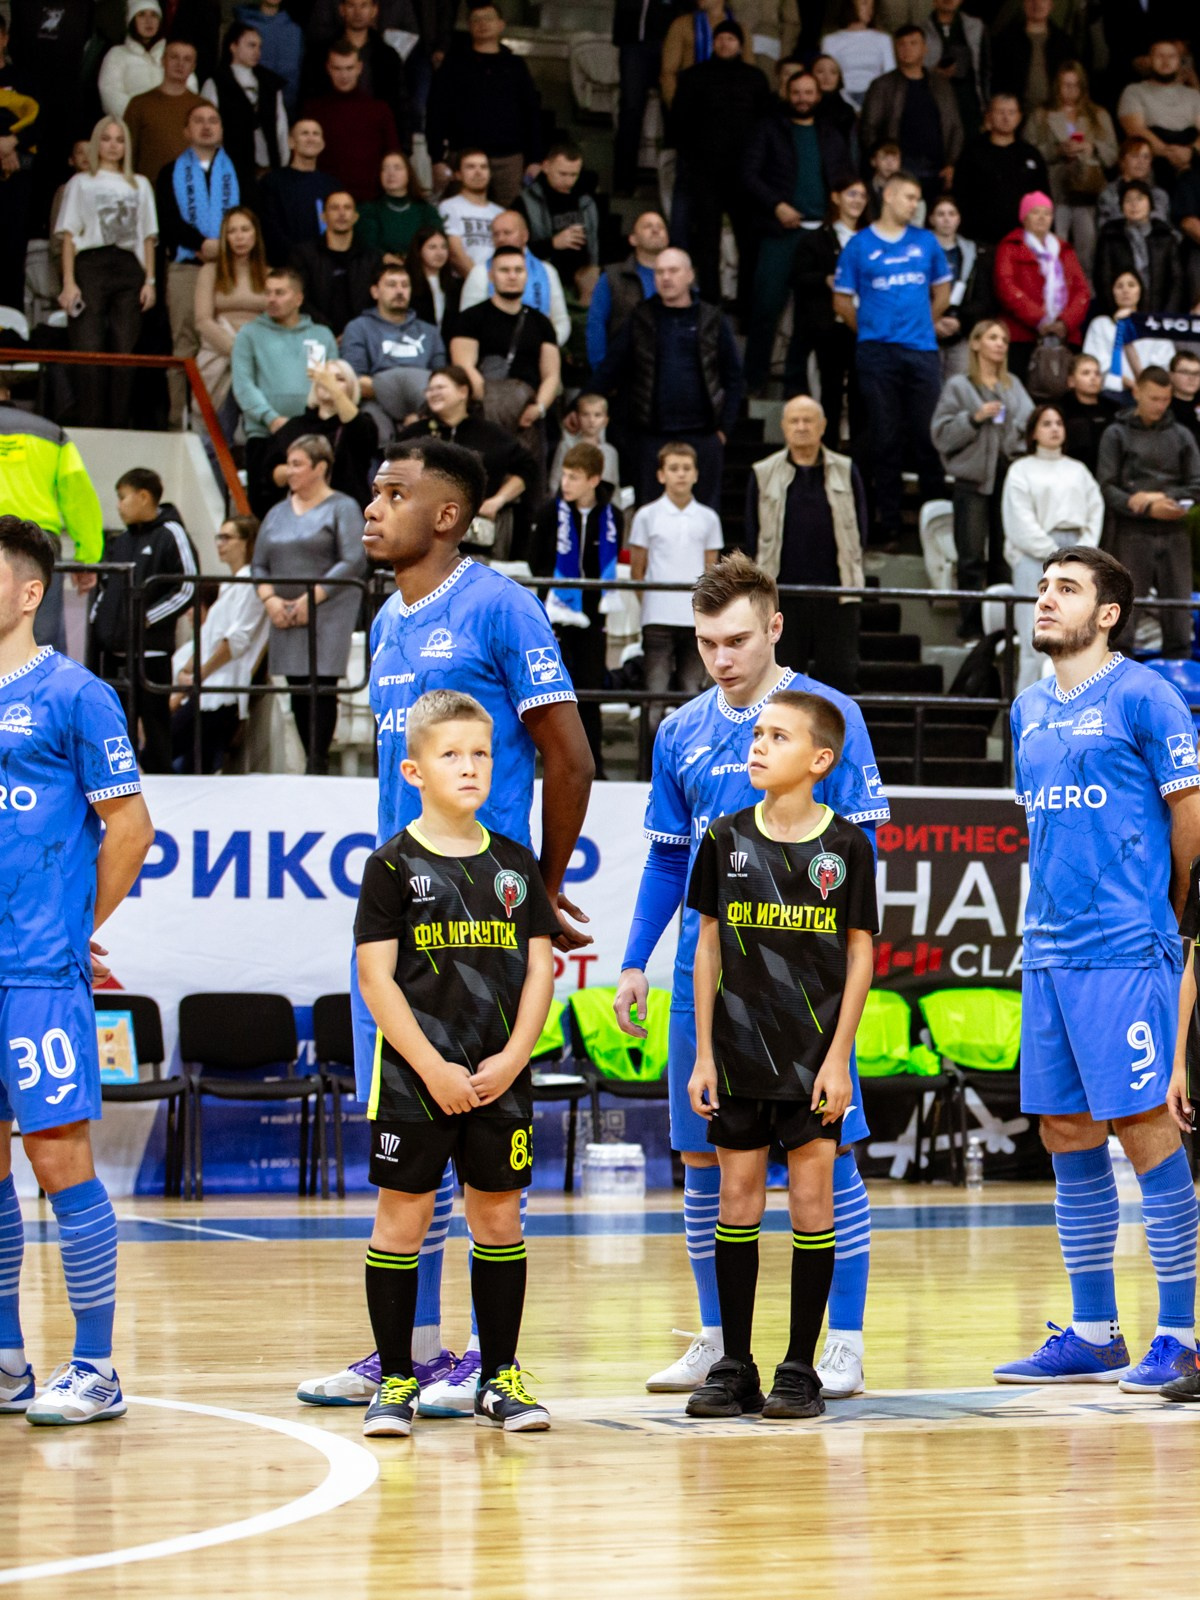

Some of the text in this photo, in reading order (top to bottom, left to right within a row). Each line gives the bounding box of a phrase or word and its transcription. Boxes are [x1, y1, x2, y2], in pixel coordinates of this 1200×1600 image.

[420, 650, 453, 659] ИРАЭРО
[378, 673, 416, 687] БЕТСИТИ
[1072, 729, 1103, 737] ИРАЭРО
[711, 762, 750, 776] БЕТСИ
[727, 901, 837, 930] ФК ИРКУТСК
[414, 921, 518, 947] ФК ИРКУТСК
[9, 1028, 76, 1090] 30
[1126, 1021, 1156, 1072] 9
[510, 1125, 533, 1171] 8
